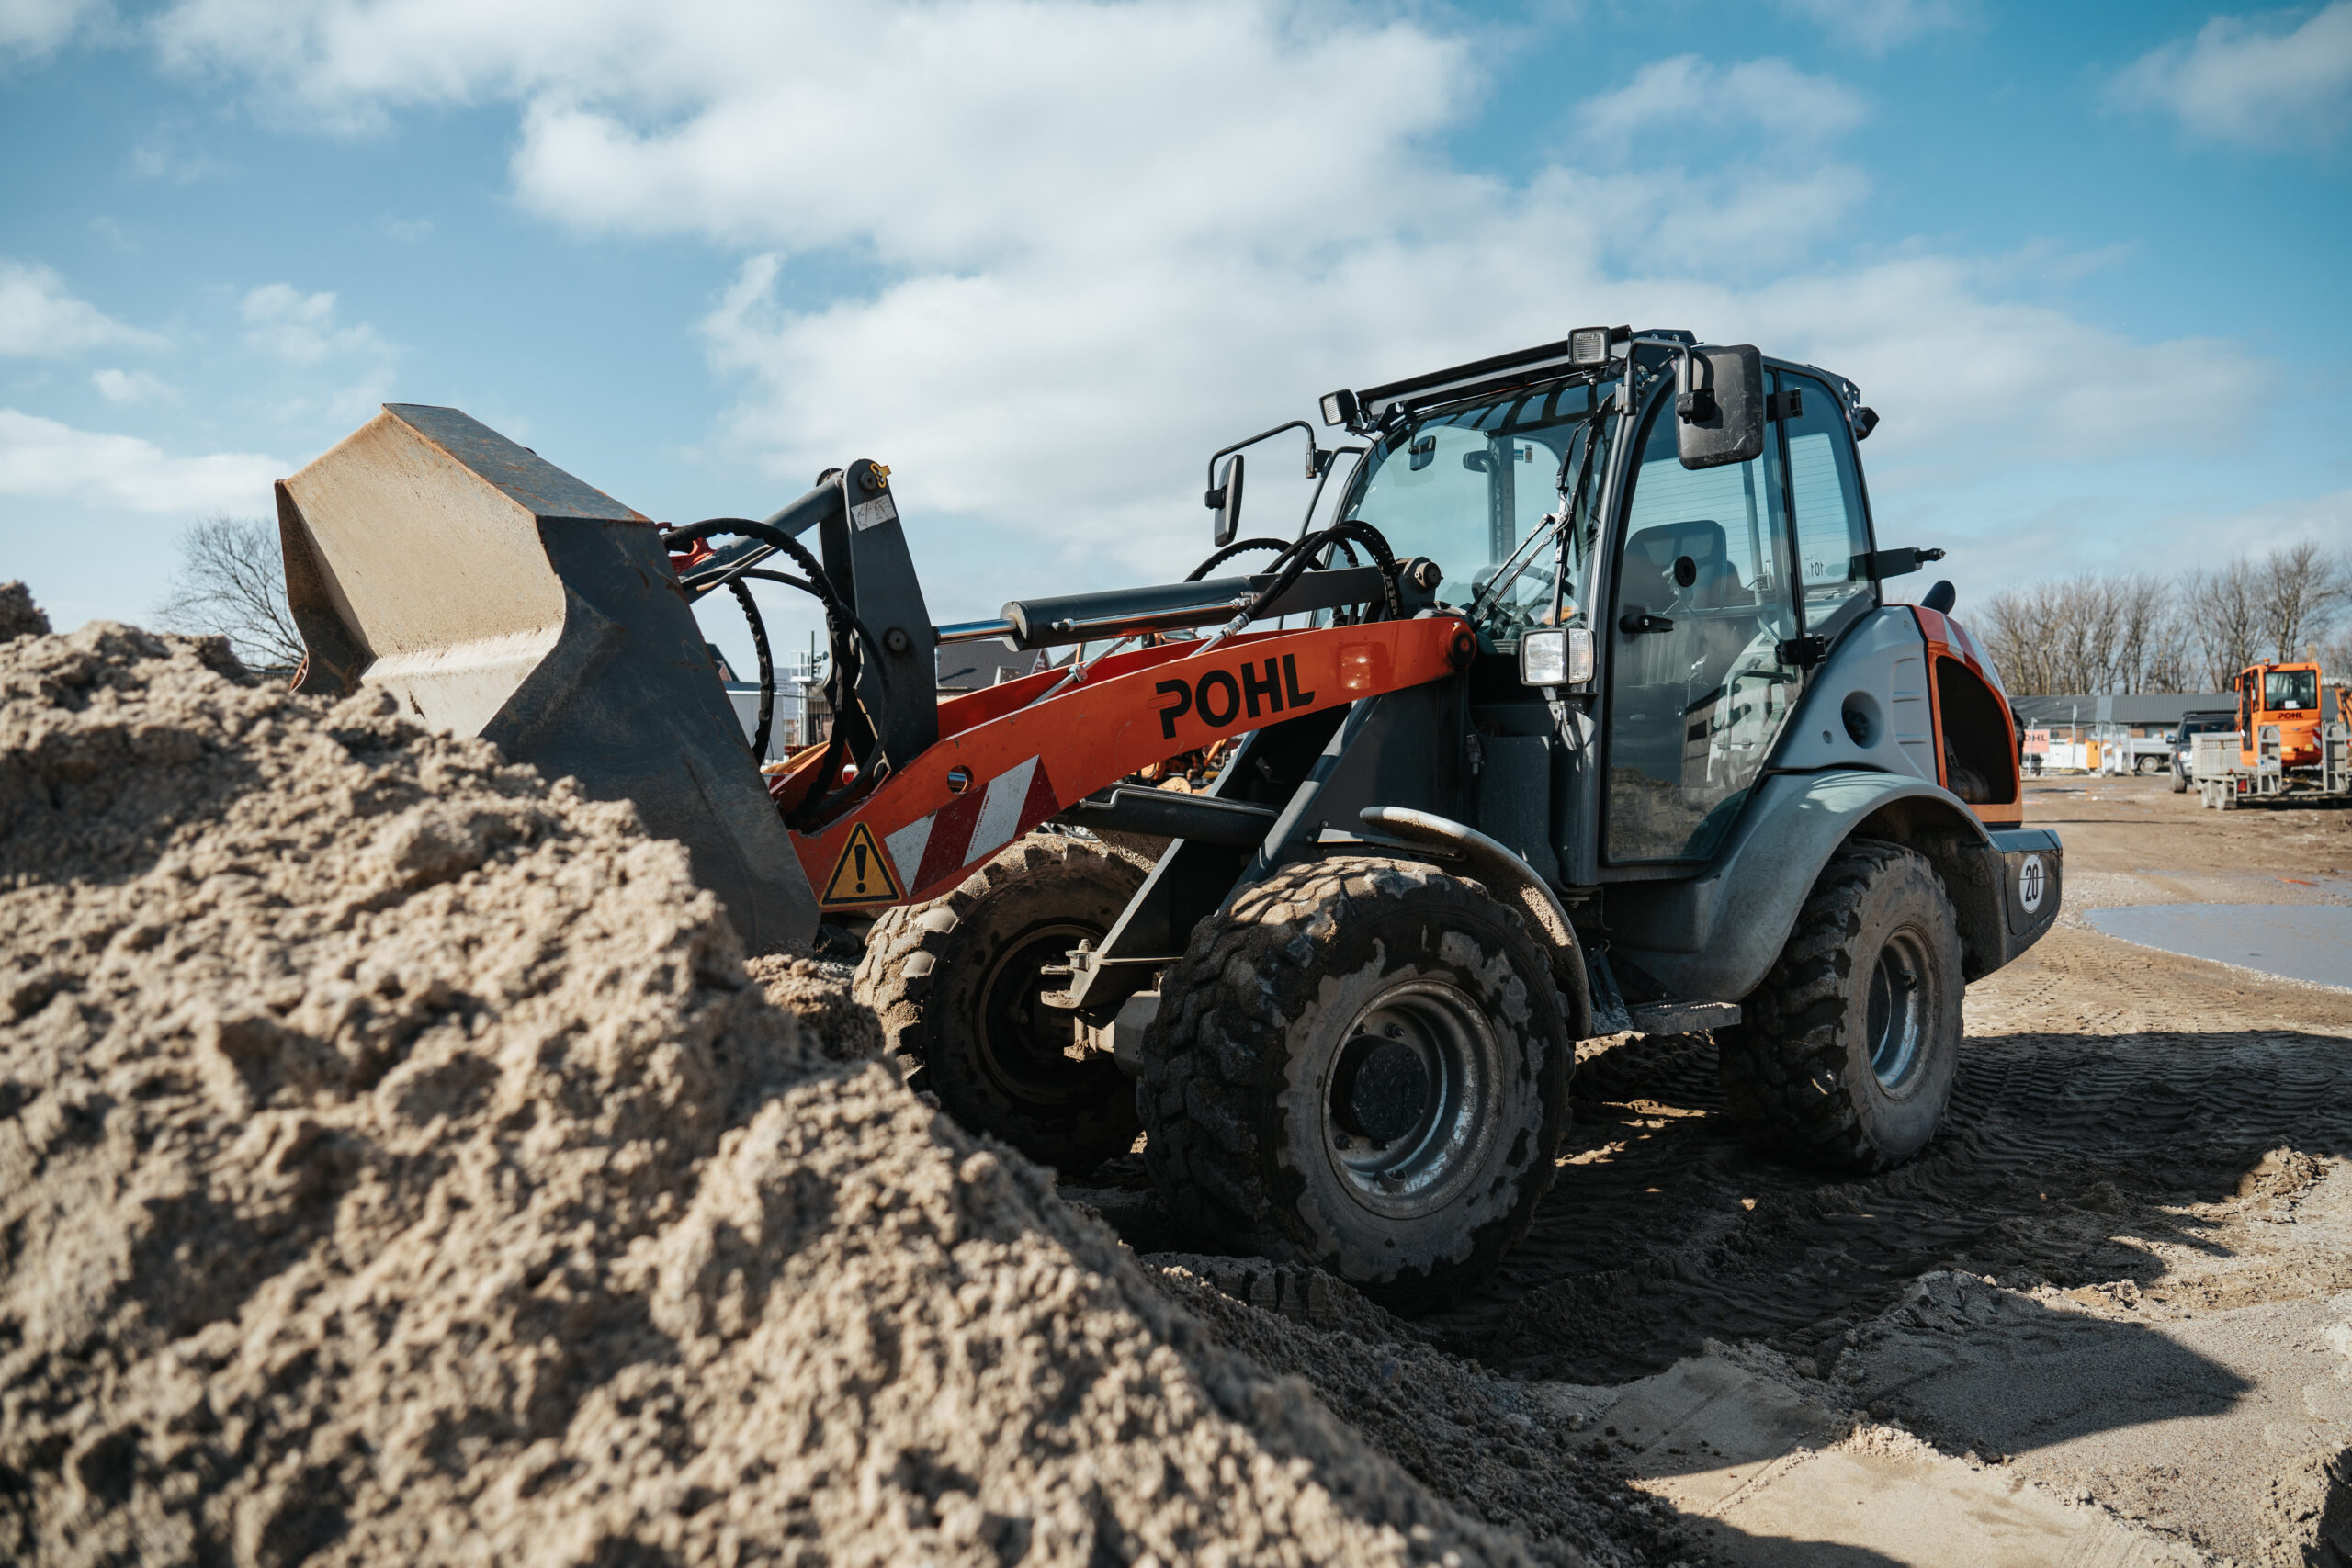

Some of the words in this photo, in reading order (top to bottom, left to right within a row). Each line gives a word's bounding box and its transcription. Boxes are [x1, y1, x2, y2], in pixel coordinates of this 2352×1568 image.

[1154, 653, 1315, 739] POHL
[2024, 734, 2047, 742] OHL
[2025, 863, 2039, 902] 20
